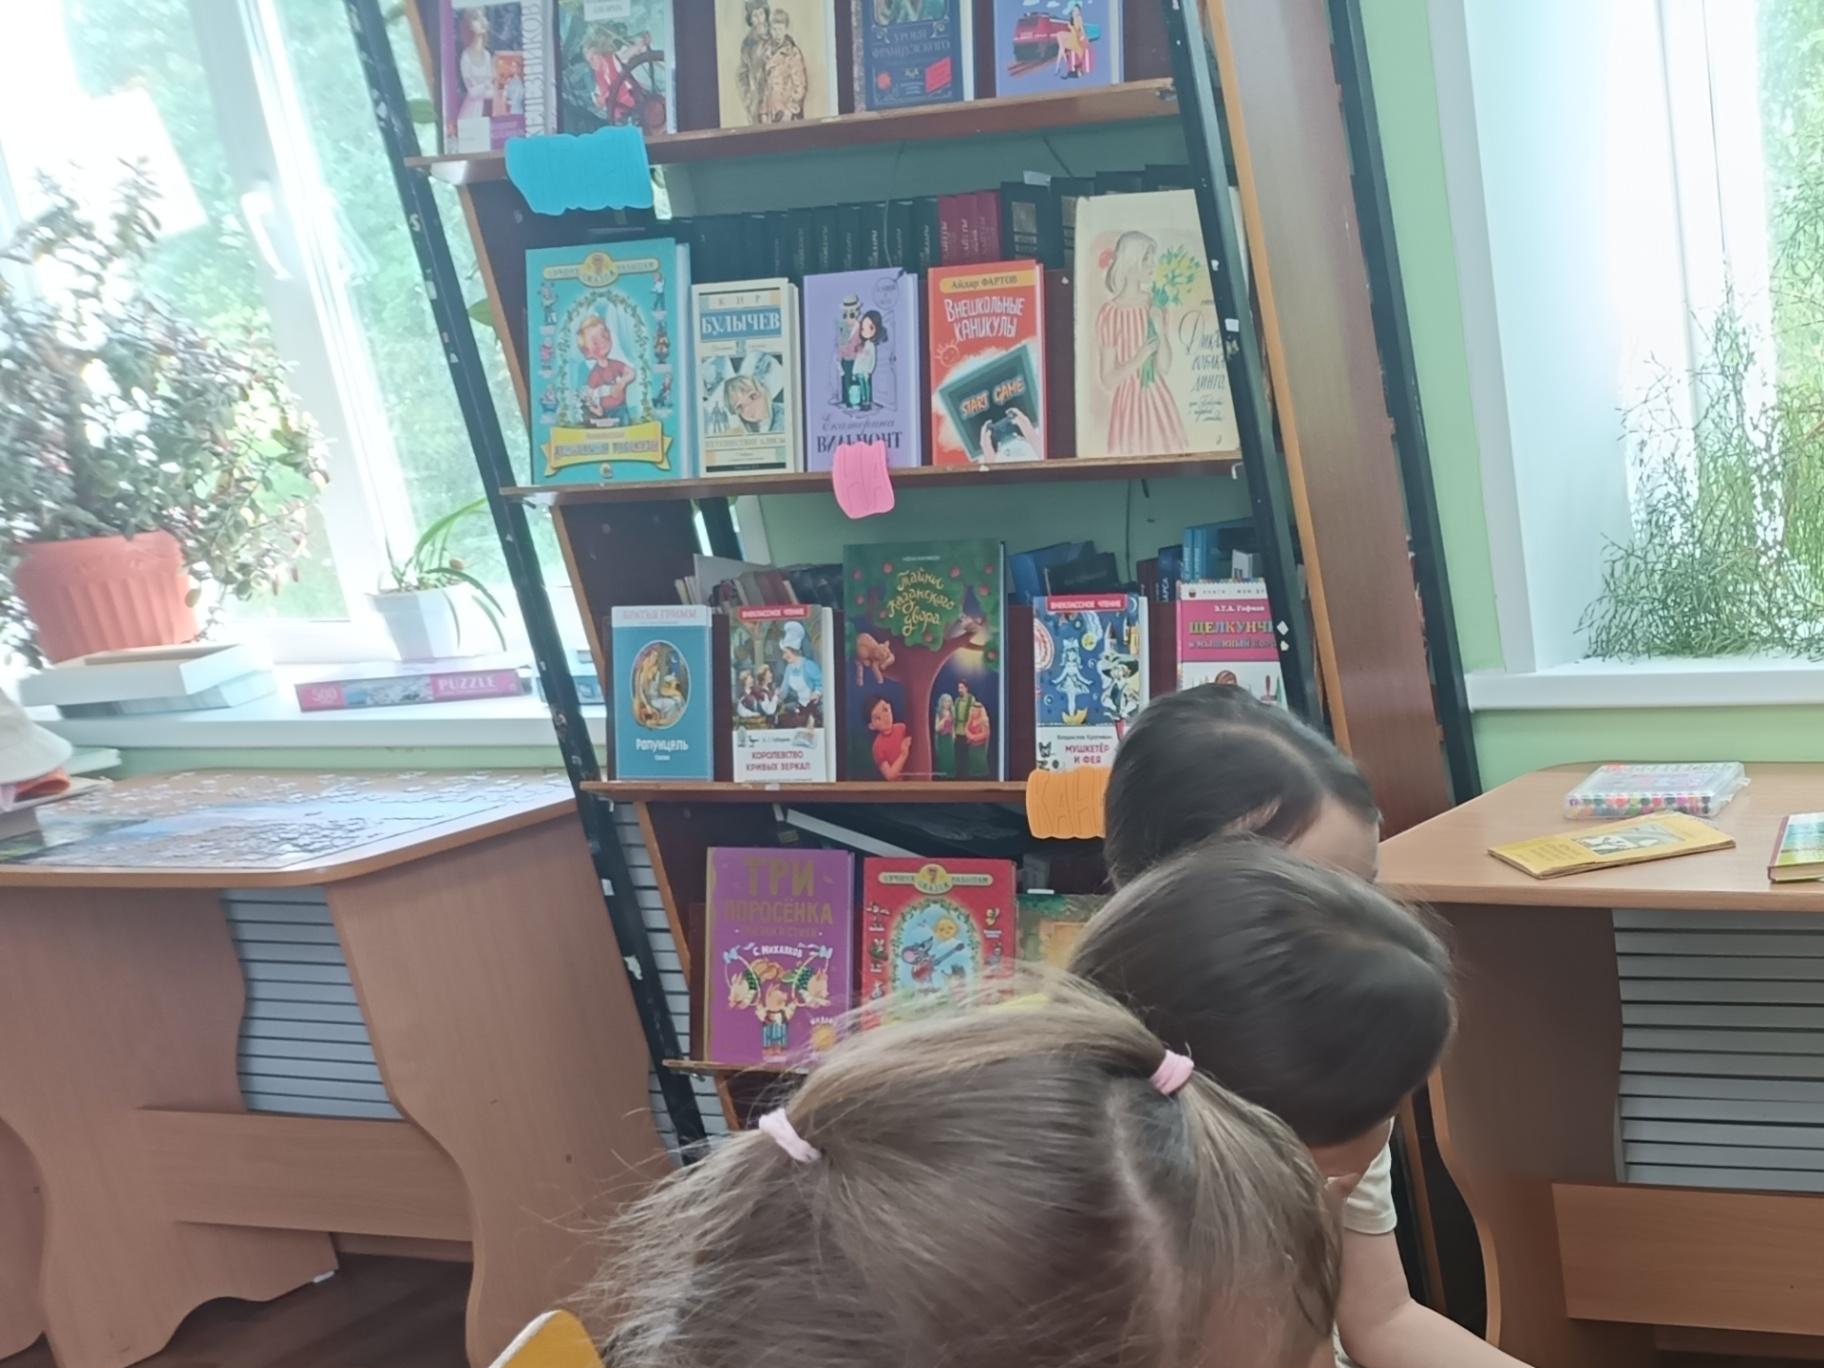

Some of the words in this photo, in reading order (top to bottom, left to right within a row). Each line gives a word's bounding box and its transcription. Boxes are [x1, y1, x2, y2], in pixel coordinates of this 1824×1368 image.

[702, 312, 780, 336] БУЛЫЧЕВ
[438, 675, 498, 691] PUZZLE
[635, 738, 689, 753] Рапунцель
[743, 858, 816, 897] ТРИ
